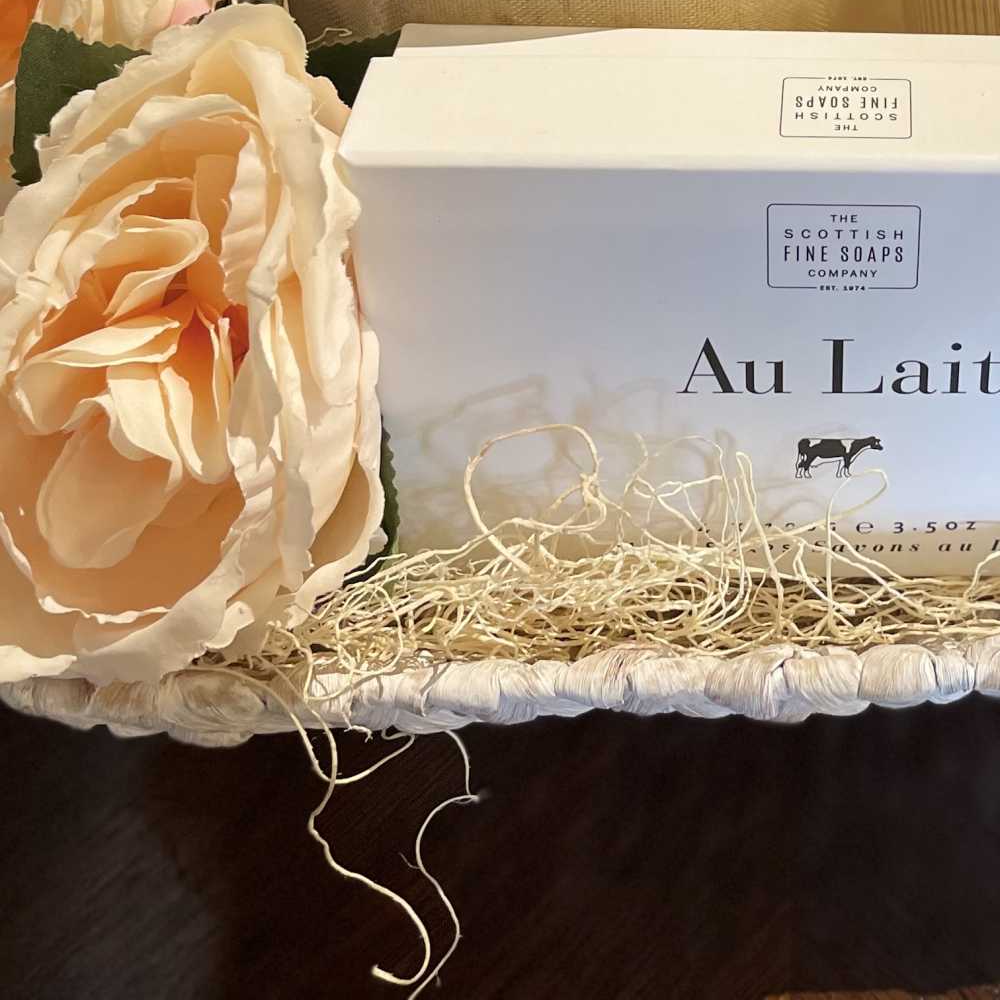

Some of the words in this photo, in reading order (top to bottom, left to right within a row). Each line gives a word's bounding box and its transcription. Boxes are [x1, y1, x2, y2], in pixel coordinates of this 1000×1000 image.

[817, 85, 877, 93] COMPANY
[795, 96, 850, 108] SOAPS
[859, 97, 897, 109] FINE
[795, 112, 897, 121] SCOTTISH
[830, 214, 859, 223] THE
[784, 229, 904, 240] SCOTTISH
[784, 245, 828, 262] FINE
[840, 246, 903, 263] SOAPS
[808, 269, 878, 278] COMPANY
[676, 337, 792, 394] Au
[938, 543, 974, 553] au
